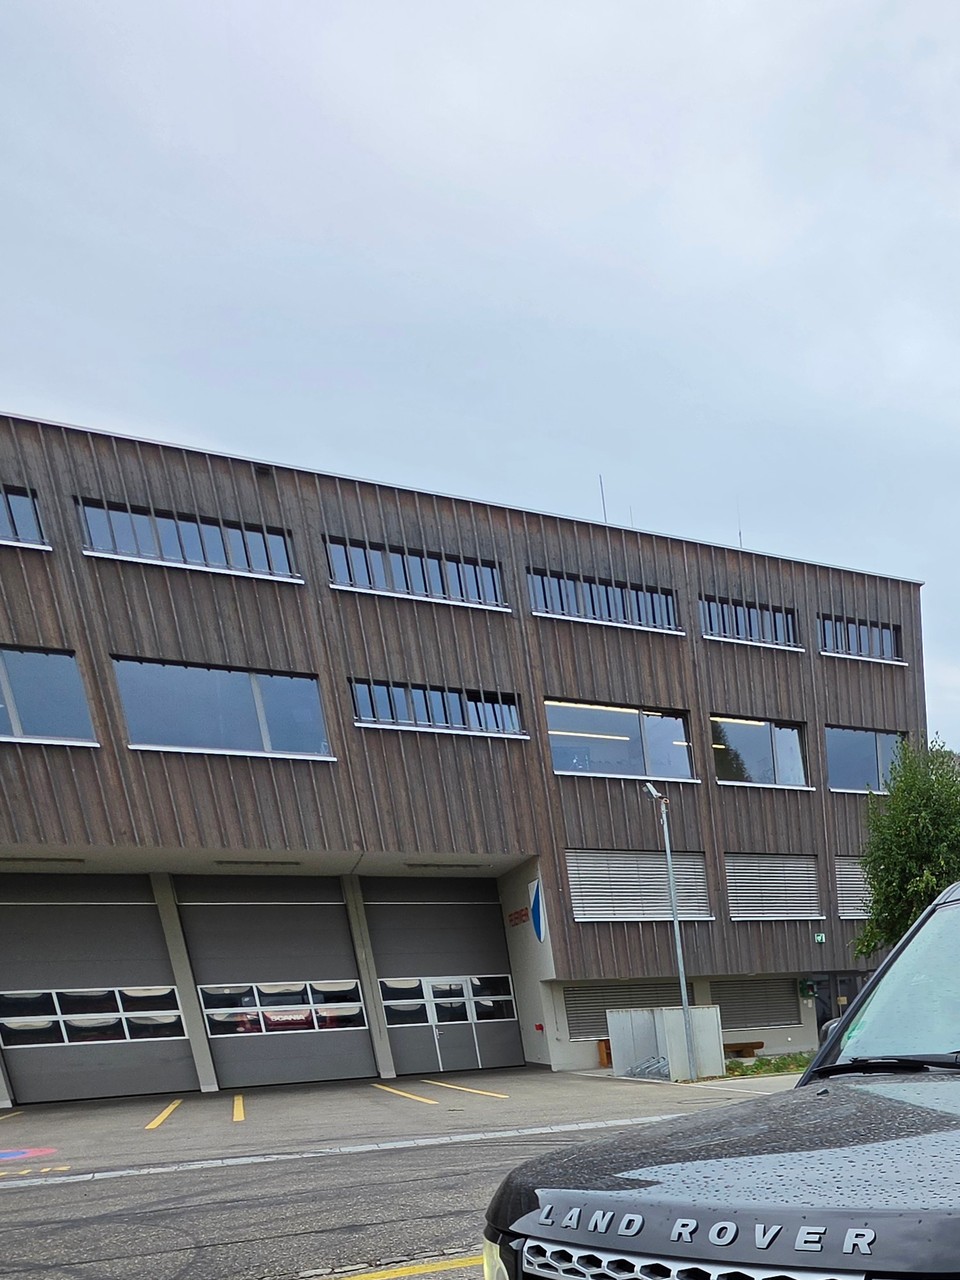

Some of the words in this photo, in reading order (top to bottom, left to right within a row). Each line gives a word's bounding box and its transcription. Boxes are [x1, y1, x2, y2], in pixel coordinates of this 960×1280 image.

[270, 1014, 306, 1022] SCANIA
[537, 1204, 645, 1237] LAND
[669, 1218, 877, 1256] ROVER
